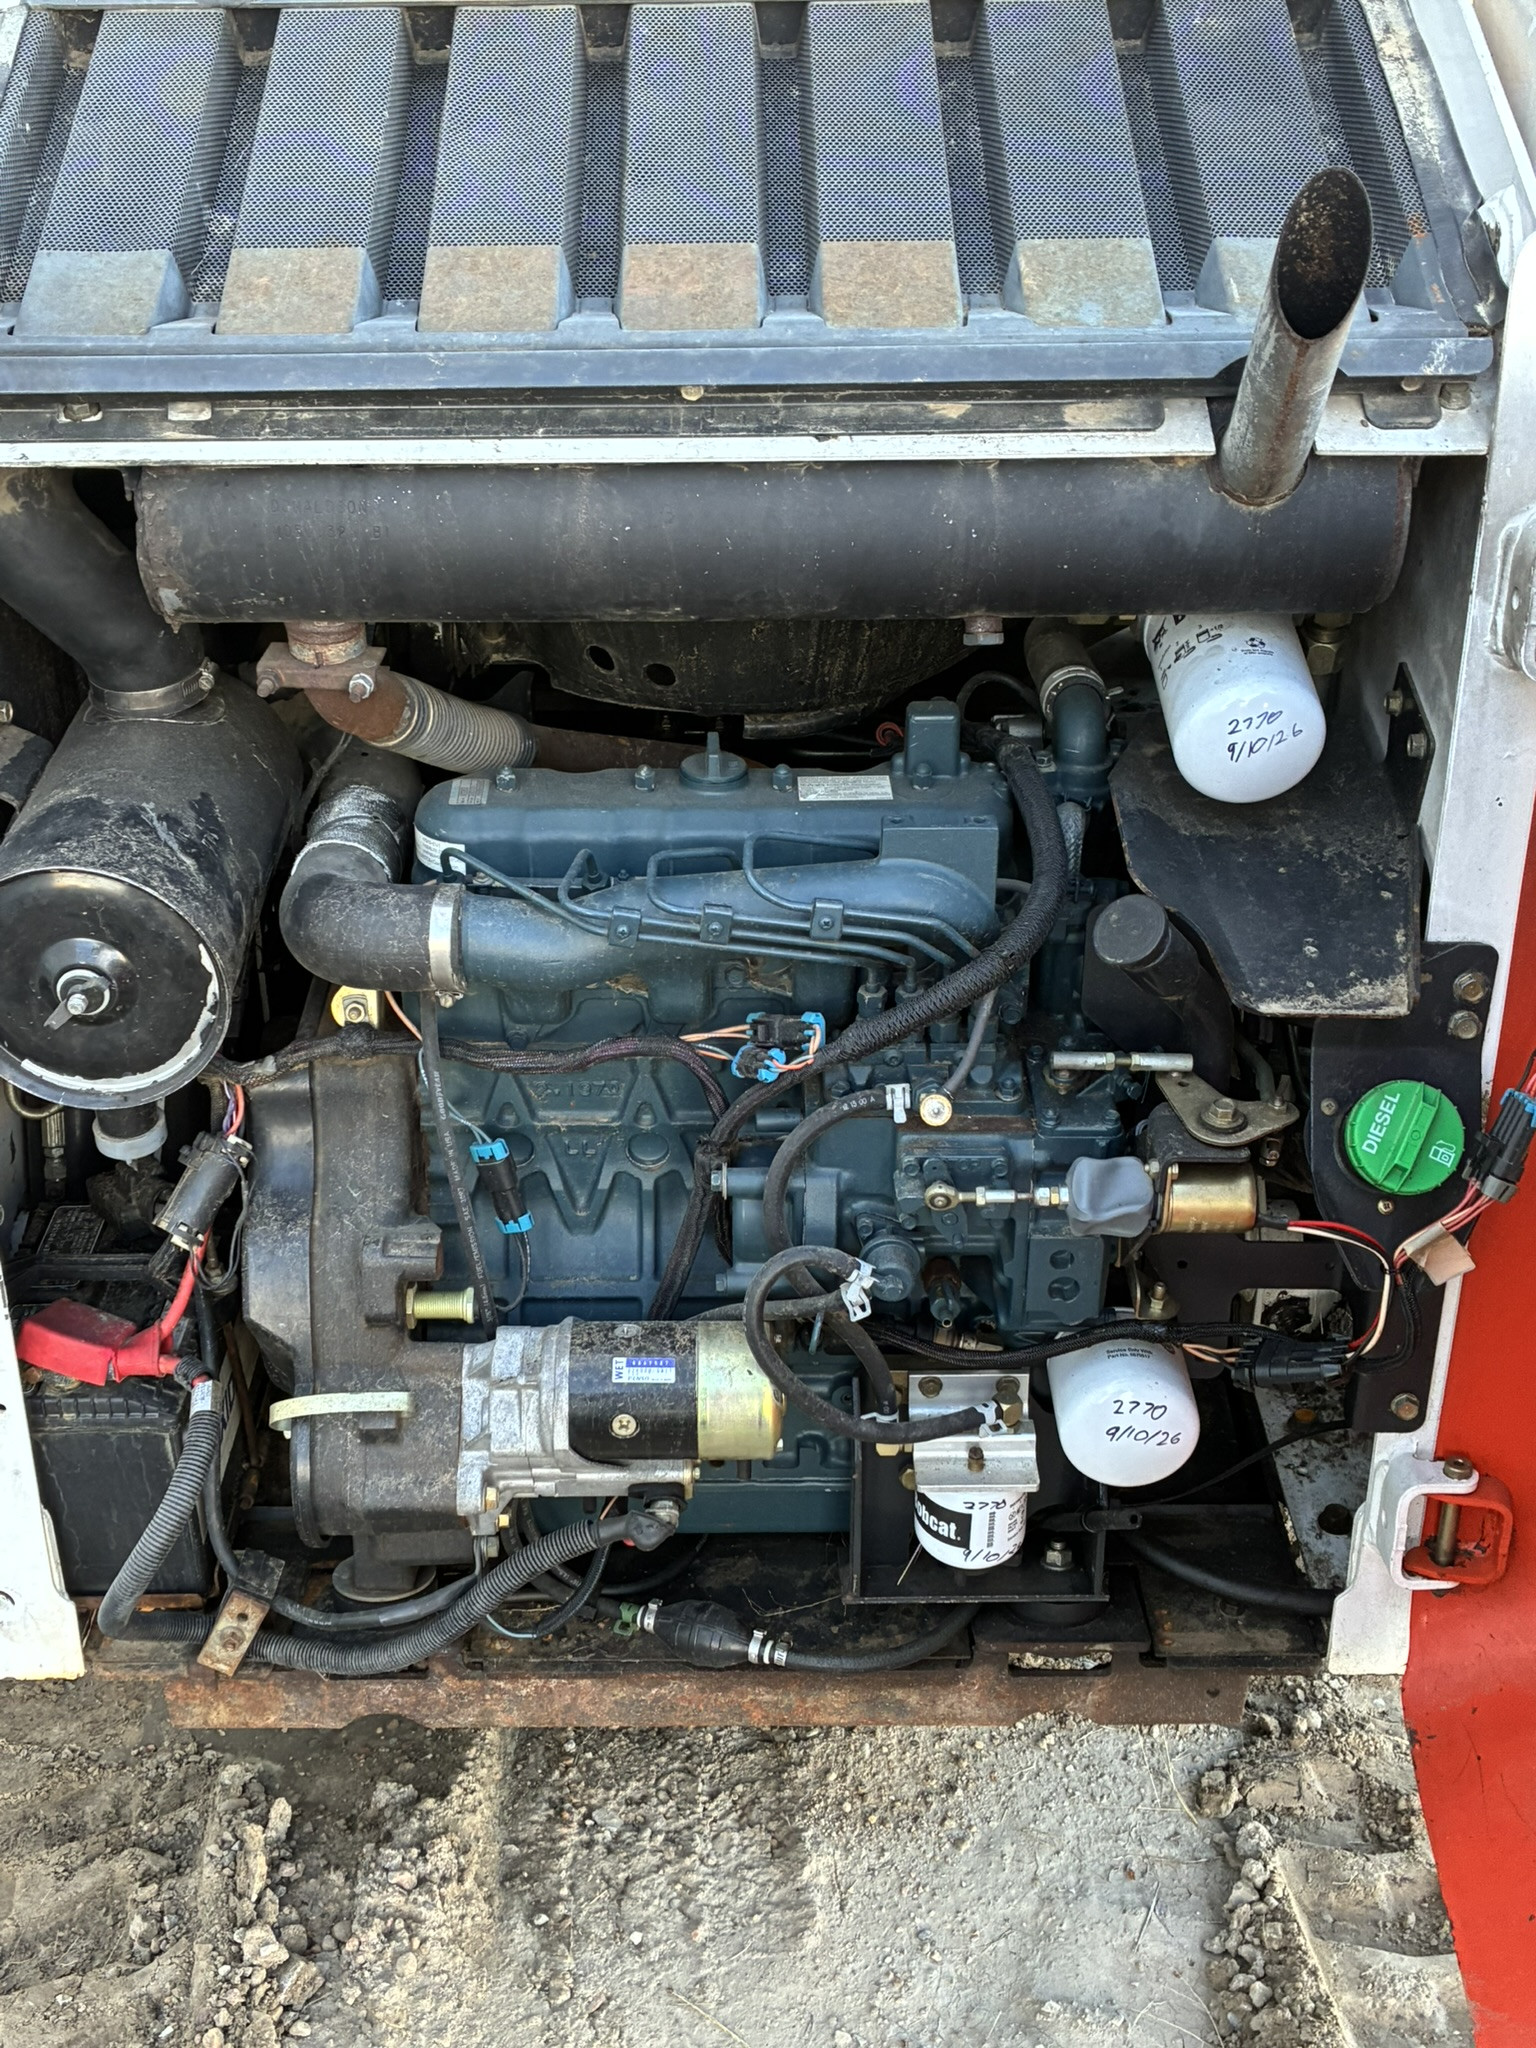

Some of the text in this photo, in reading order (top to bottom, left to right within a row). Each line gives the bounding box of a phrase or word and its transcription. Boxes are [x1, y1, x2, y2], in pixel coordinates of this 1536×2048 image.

[1227, 710, 1284, 736] 2770
[433, 1071, 448, 1120] GOODYEAR
[1361, 1093, 1401, 1155] DIESEL
[443, 1130, 454, 1147] USA
[447, 1149, 455, 1158] IN
[450, 1158, 461, 1181] MADE
[461, 1205, 472, 1221] SAE
[614, 1359, 625, 1379] WET
[1112, 1399, 1168, 1421] 2770
[1105, 1425, 1182, 1447] 9/10/26
